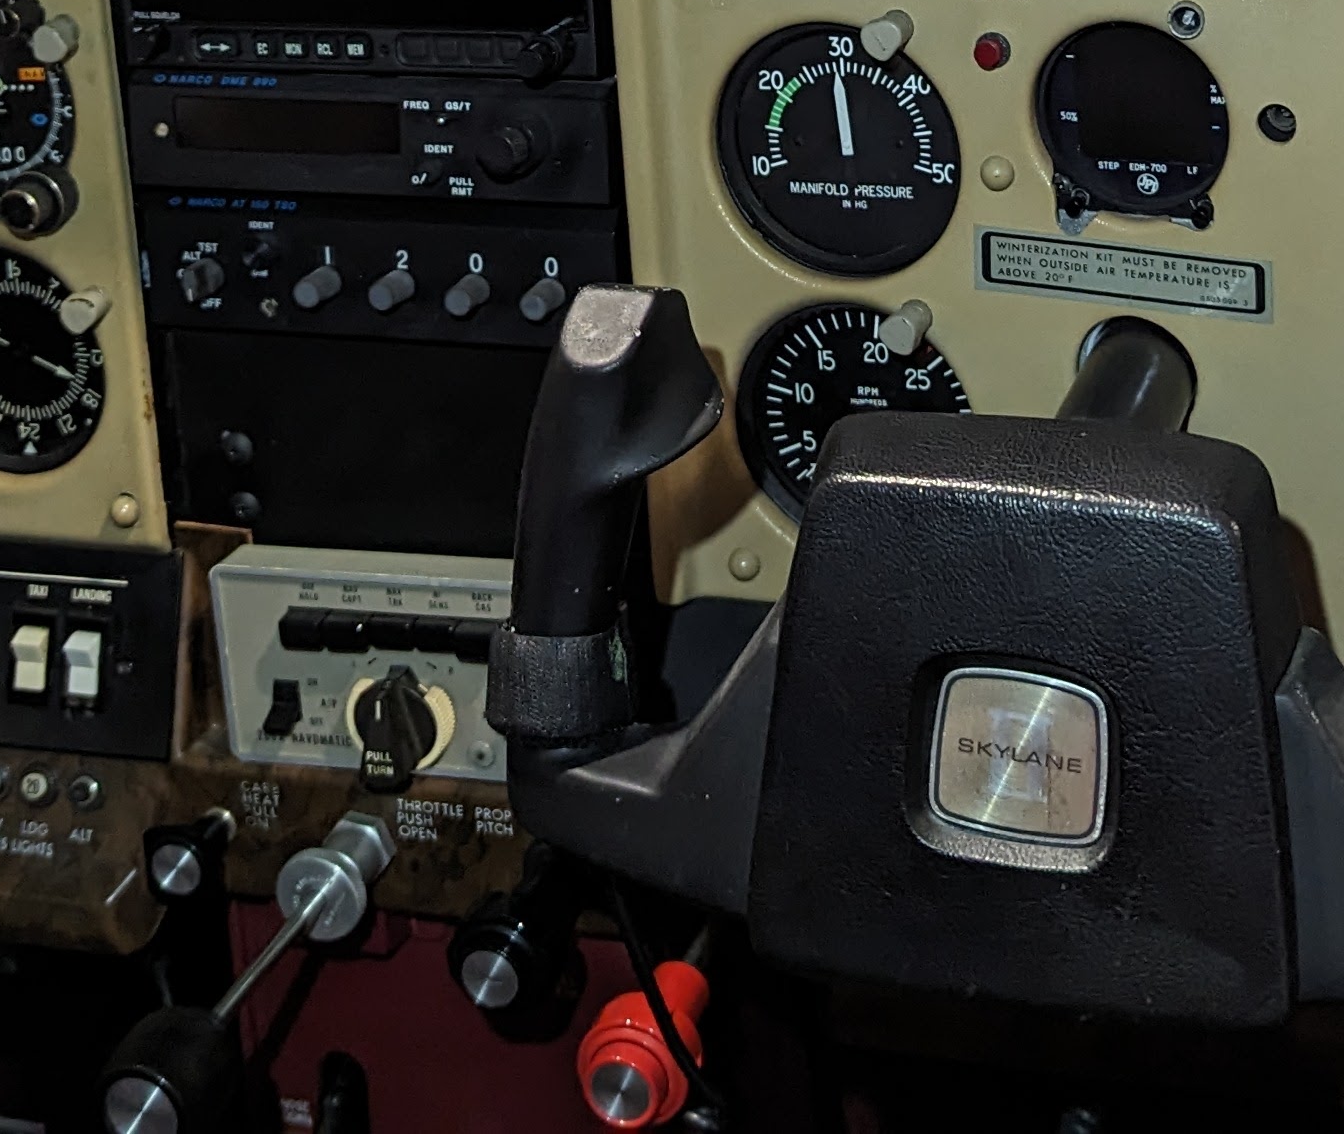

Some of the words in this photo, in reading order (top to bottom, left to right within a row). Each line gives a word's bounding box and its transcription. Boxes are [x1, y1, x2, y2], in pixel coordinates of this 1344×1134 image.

[829, 37, 853, 57] 30
[169, 75, 212, 84] NARCO
[221, 77, 246, 85] DME
[758, 71, 783, 90] 20
[424, 145, 453, 154] IDENT
[752, 156, 770, 176] 10
[449, 177, 474, 186] PULL
[790, 182, 849, 196] MANIFOLD
[855, 185, 914, 199] PRESSURE
[182, 251, 201, 261] ALT
[997, 241, 1088, 259] WINTERIZATION
[1096, 253, 1113, 262] KIT
[1122, 257, 1155, 267] MUST
[1164, 261, 1177, 270] BE
[1186, 264, 1246, 278] REMOVED
[997, 253, 1032, 265] WHEN
[1040, 259, 1088, 272] OUTSIDE
[1097, 267, 1115, 276] AIR
[1124, 269, 1209, 287] TEMPERATURE
[1218, 280, 1230, 289] IS
[997, 268, 1036, 280] ABOVE
[818, 350, 836, 370] 15
[863, 342, 888, 363] 20
[905, 368, 930, 389] 25
[795, 382, 813, 403] 10
[857, 386, 878, 395] RPM
[71, 588, 112, 603] LANDING
[366, 751, 392, 762] PULL
[959, 738, 1081, 774] SKYLANE
[367, 764, 393, 775] TURN
[396, 798, 464, 816] THROTTLE
[397, 812, 433, 826] PUSH
[70, 829, 92, 843] ALT
[399, 825, 437, 841] OPEN
[476, 821, 513, 836] PITCH
[11, 840, 54, 857] LIGHTS
